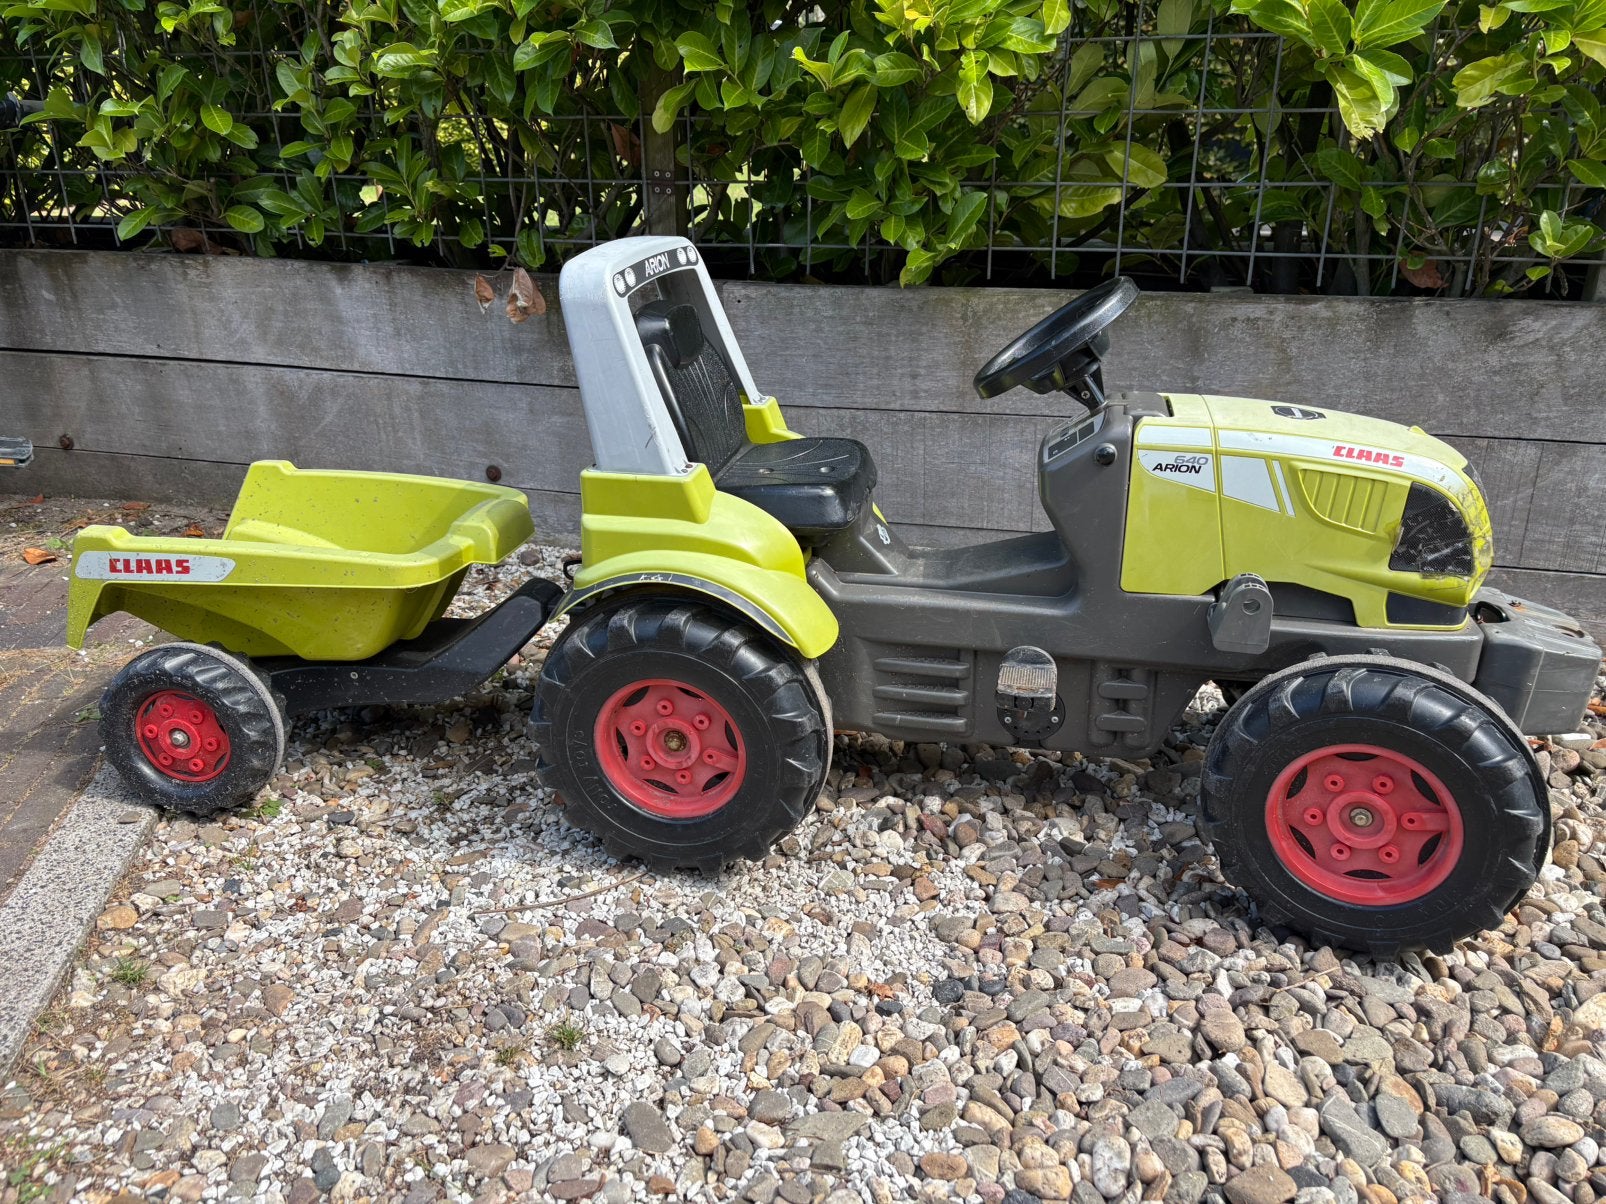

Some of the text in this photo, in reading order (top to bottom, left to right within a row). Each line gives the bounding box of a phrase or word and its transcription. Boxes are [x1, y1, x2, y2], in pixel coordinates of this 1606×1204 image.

[644, 252, 671, 278] ARION
[1174, 455, 1209, 466] 640
[1333, 445, 1405, 468] CLAAS
[1151, 462, 1202, 474] ARION
[108, 558, 191, 575] CLAAS
